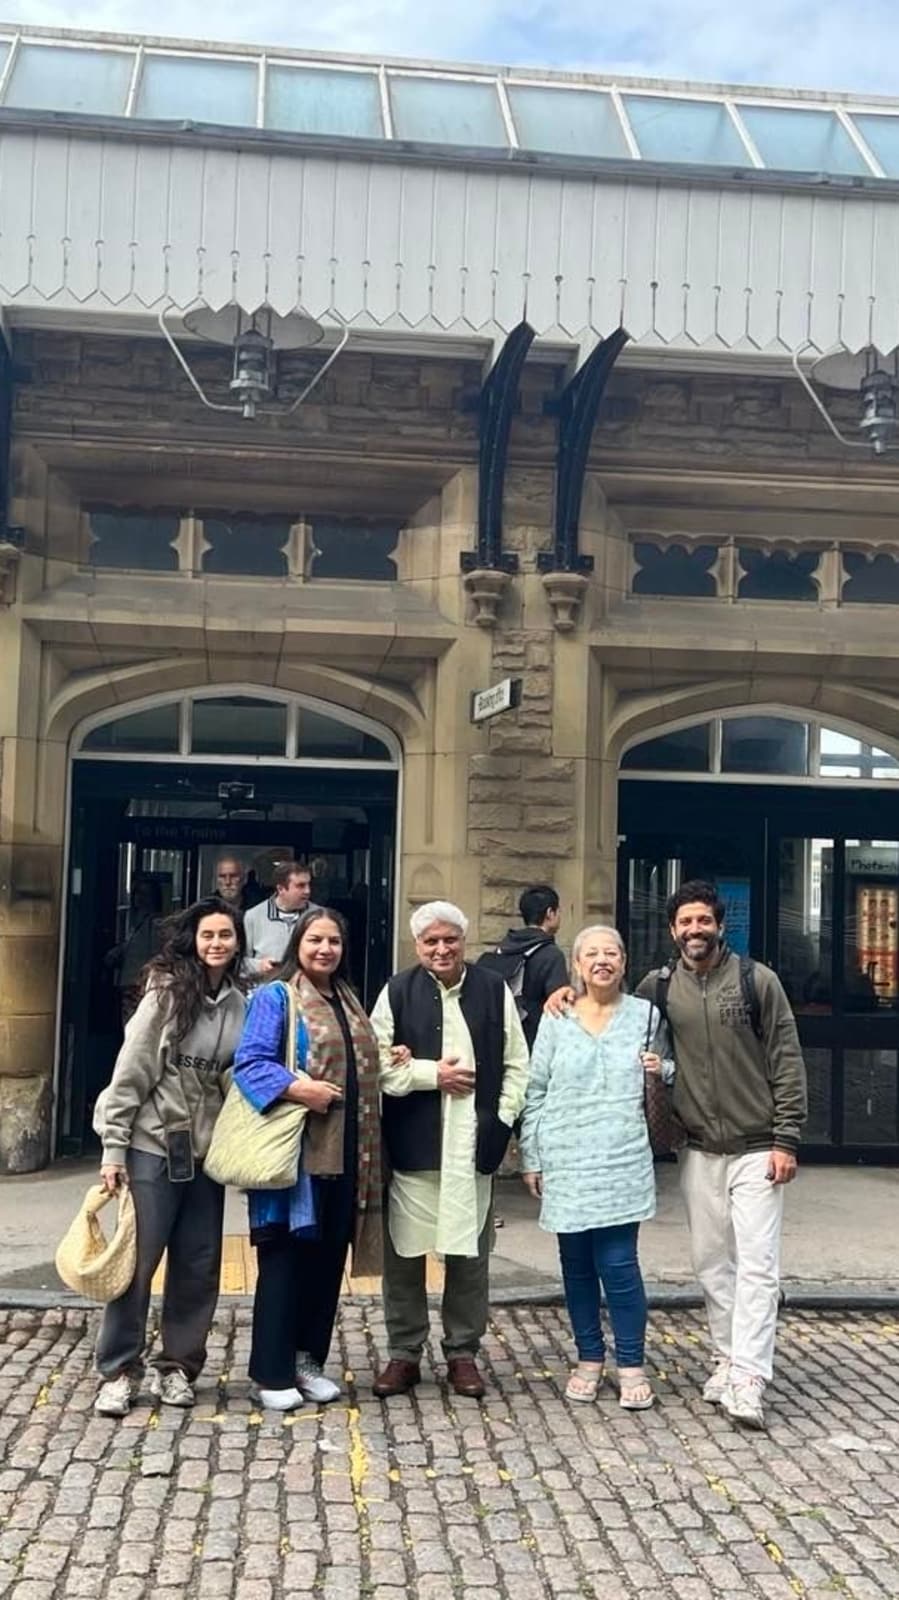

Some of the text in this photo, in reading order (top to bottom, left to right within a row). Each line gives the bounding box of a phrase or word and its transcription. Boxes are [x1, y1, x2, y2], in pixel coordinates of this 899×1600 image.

[133, 822, 227, 839] To the Trains
